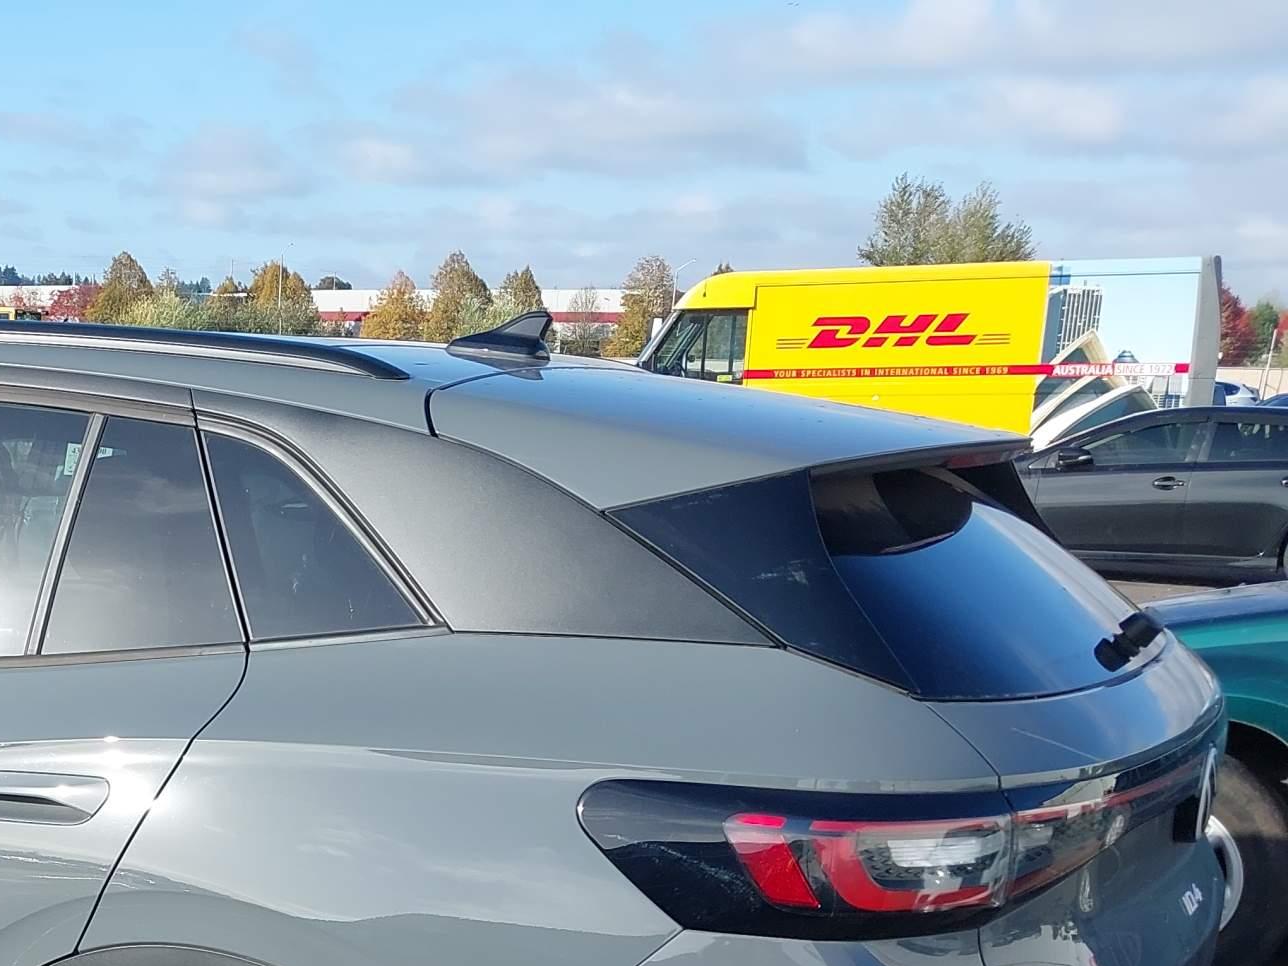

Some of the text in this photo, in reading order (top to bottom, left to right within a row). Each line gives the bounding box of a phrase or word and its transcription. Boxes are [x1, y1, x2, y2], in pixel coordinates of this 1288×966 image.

[807, 313, 977, 348] DHL
[773, 366, 1009, 378] YOUR SPECIALISTS IN INTERNATIONAL SINCE 1969
[1053, 365, 1173, 376] AUSTRALIA SINCE 1972
